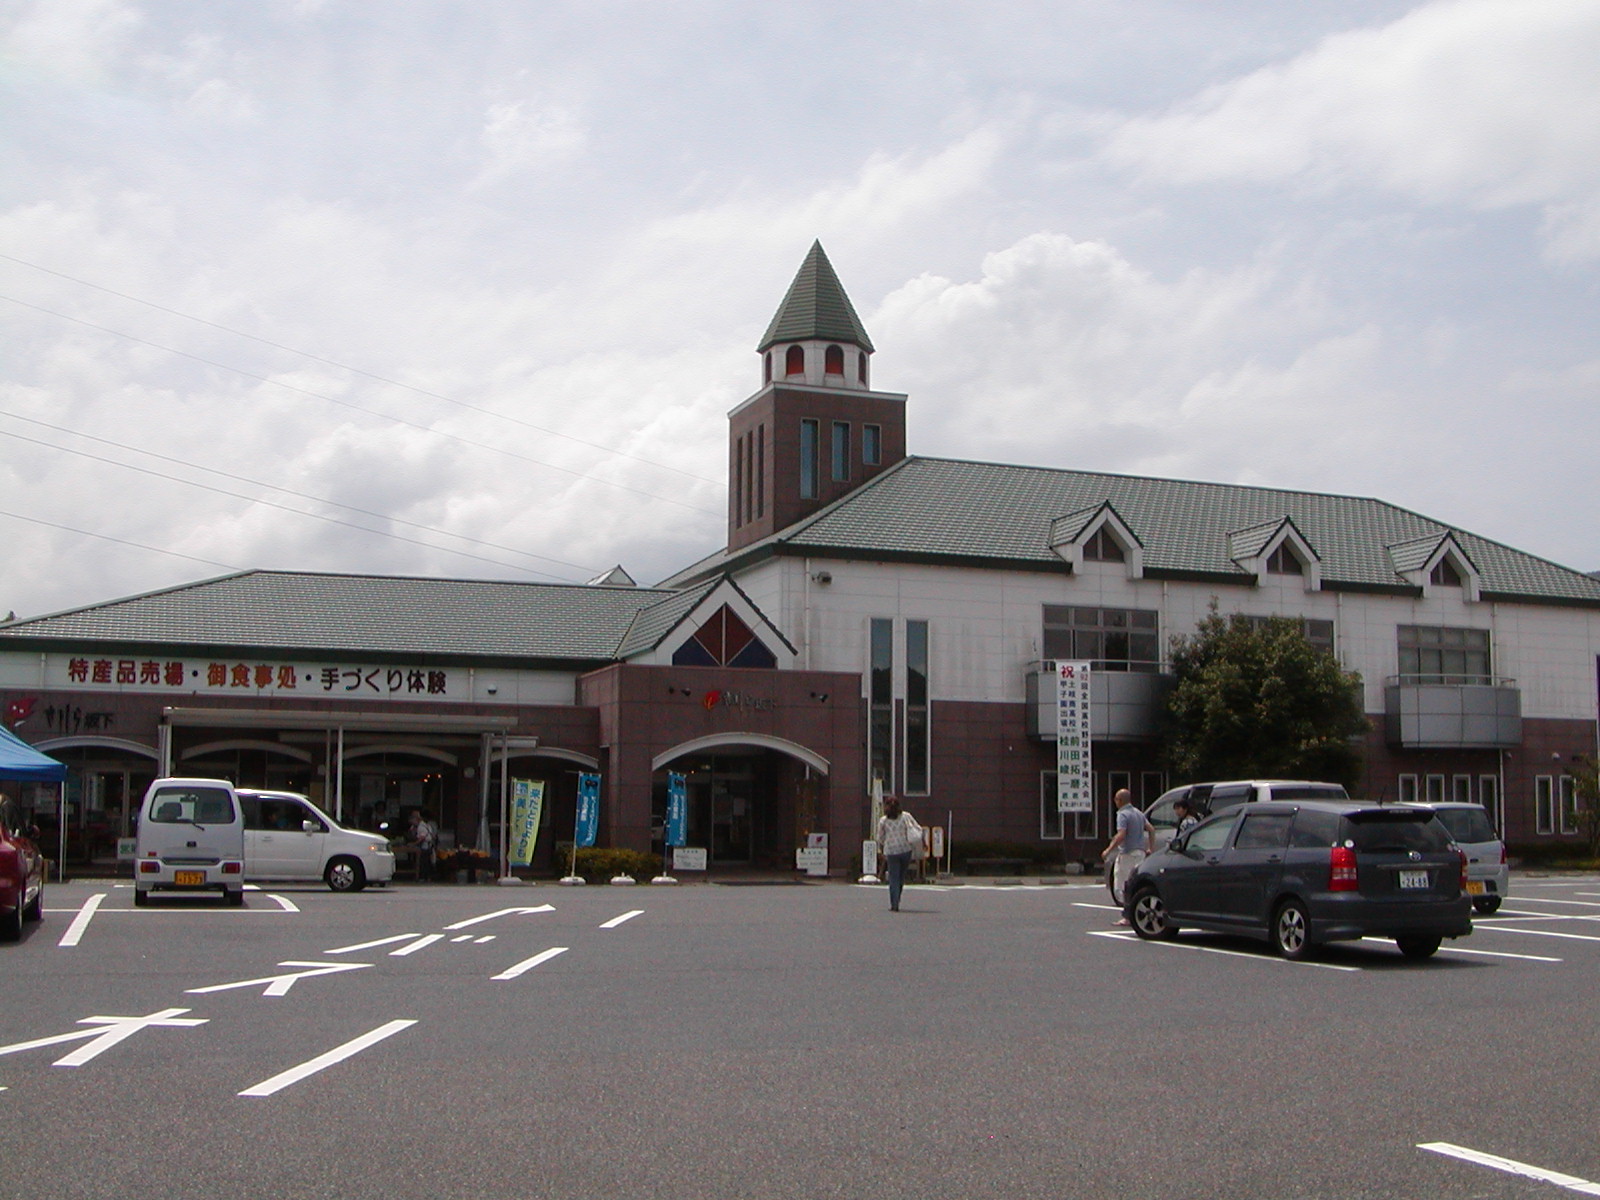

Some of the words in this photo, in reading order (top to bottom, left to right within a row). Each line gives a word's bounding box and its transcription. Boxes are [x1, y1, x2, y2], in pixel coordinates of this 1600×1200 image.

[68, 657, 447, 694] 特産品売場・御食事処・手づくり体験
[1060, 665, 1075, 679] 祝
